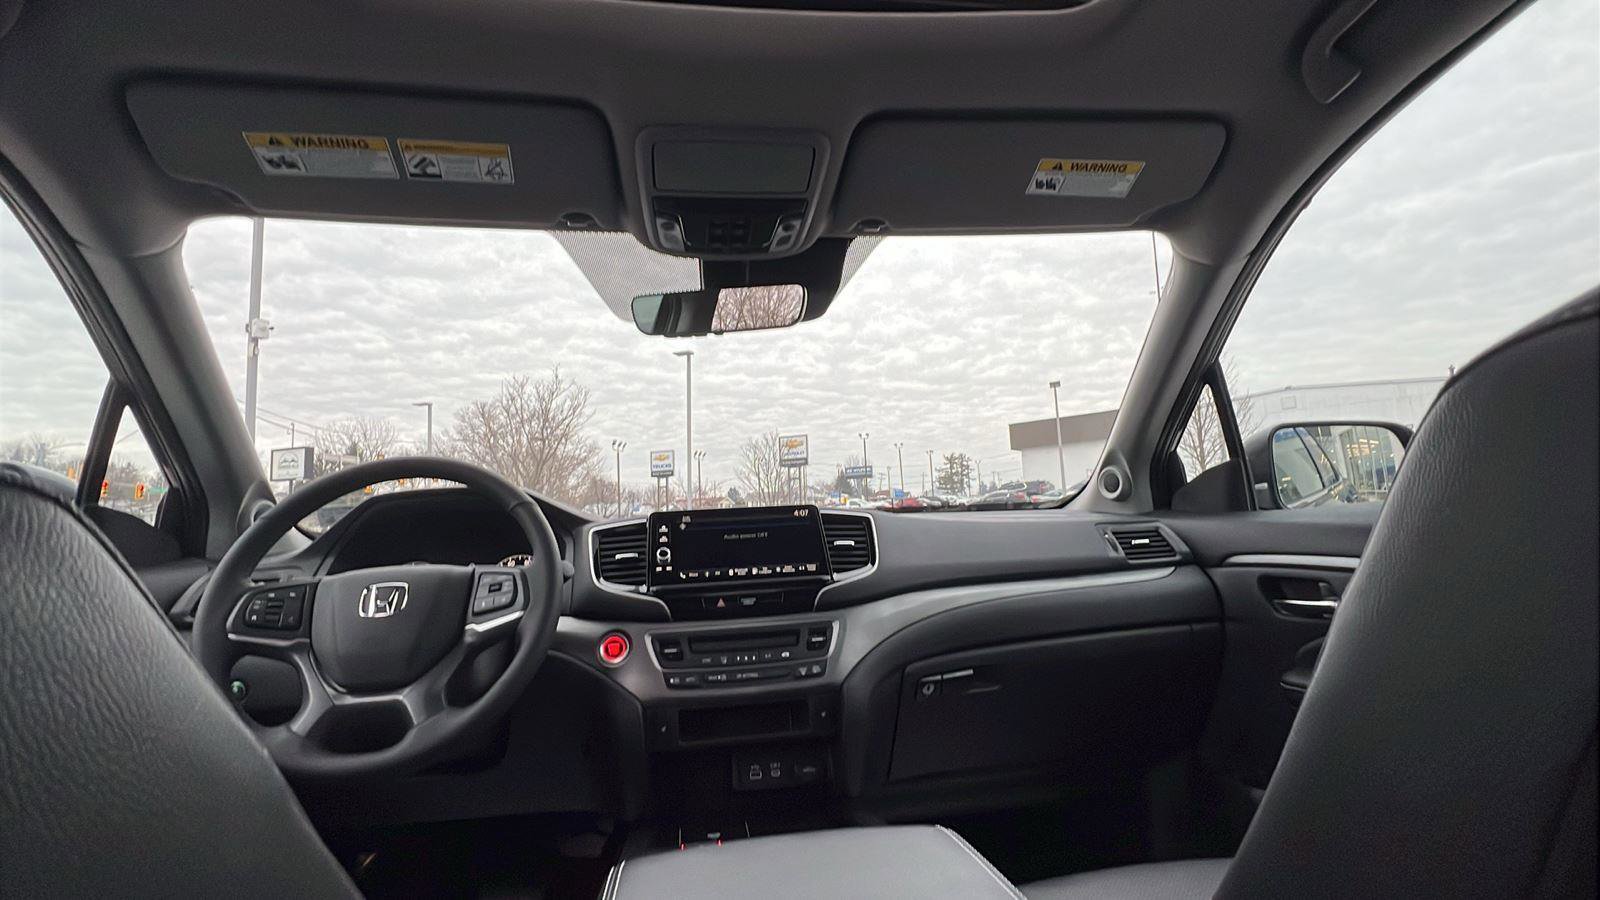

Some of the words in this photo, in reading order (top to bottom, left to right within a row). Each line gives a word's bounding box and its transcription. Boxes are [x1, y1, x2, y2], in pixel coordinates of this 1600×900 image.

[290, 135, 370, 149] WARNING
[1069, 161, 1128, 174] WARNING
[793, 508, 809, 517] 4:07
